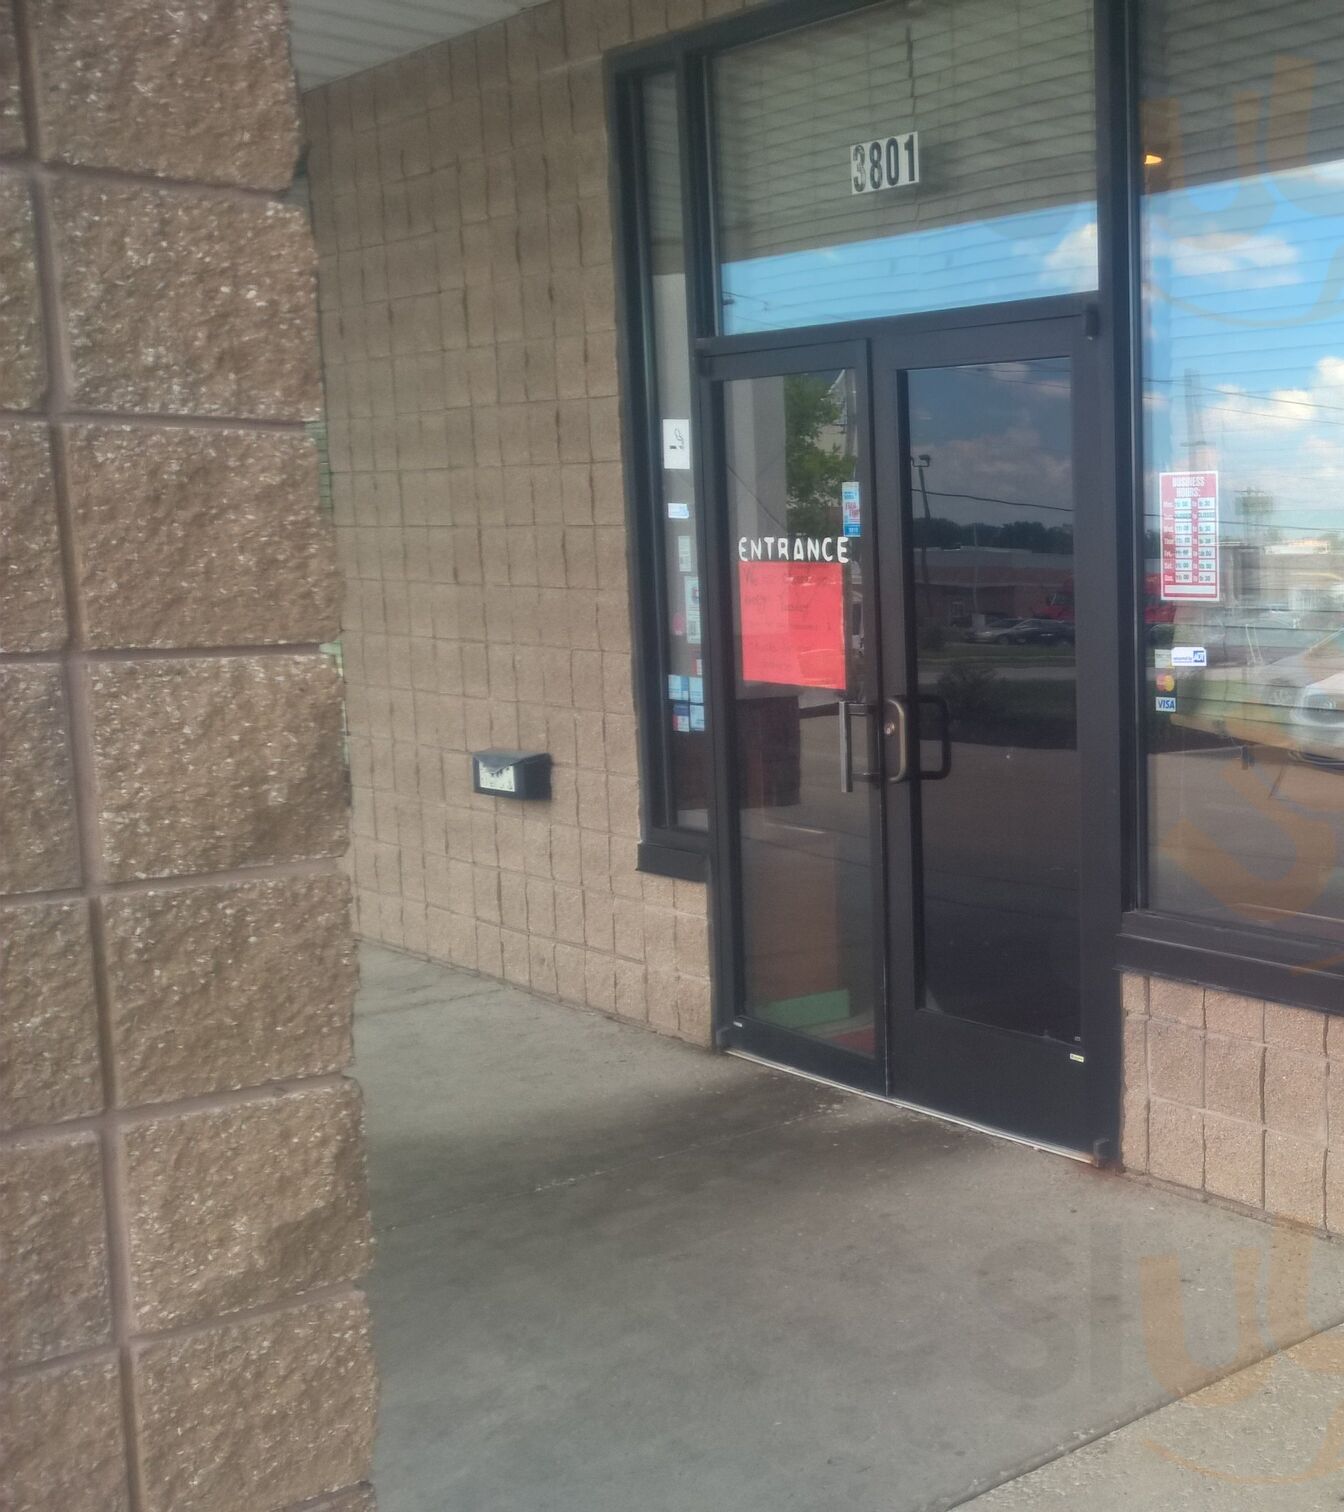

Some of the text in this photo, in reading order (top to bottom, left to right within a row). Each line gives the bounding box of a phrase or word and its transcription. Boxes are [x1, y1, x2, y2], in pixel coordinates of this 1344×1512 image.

[853, 134, 916, 193] 3801
[738, 536, 849, 563] ENTRANCE
[1158, 700, 1175, 709] VISA
